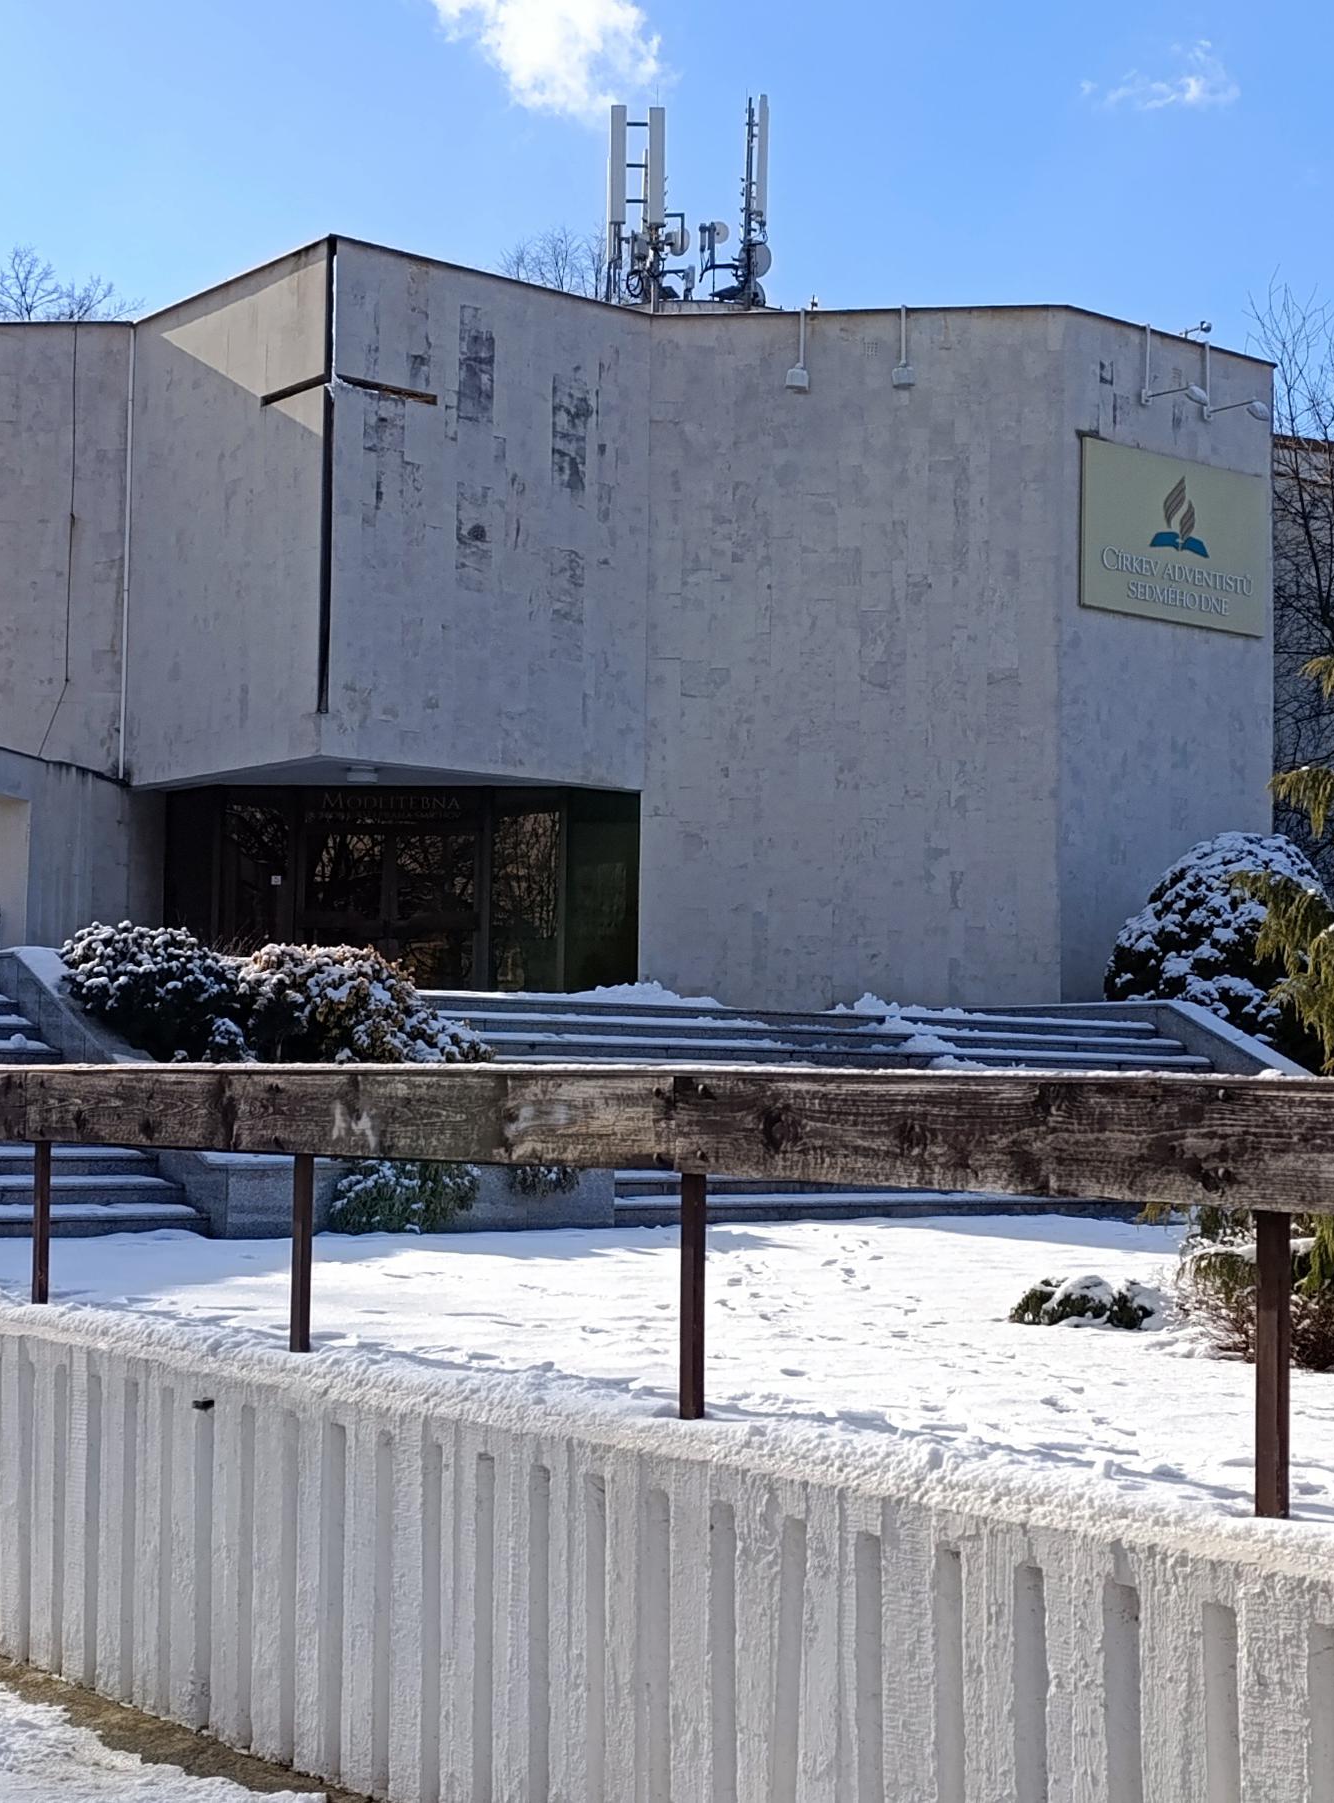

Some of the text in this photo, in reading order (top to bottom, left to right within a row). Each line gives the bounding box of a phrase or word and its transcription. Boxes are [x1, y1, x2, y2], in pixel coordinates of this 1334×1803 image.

[1163, 564, 1254, 596] ADVENTISTŮ
[1128, 580, 1231, 616] SEDMÉHO DNE
